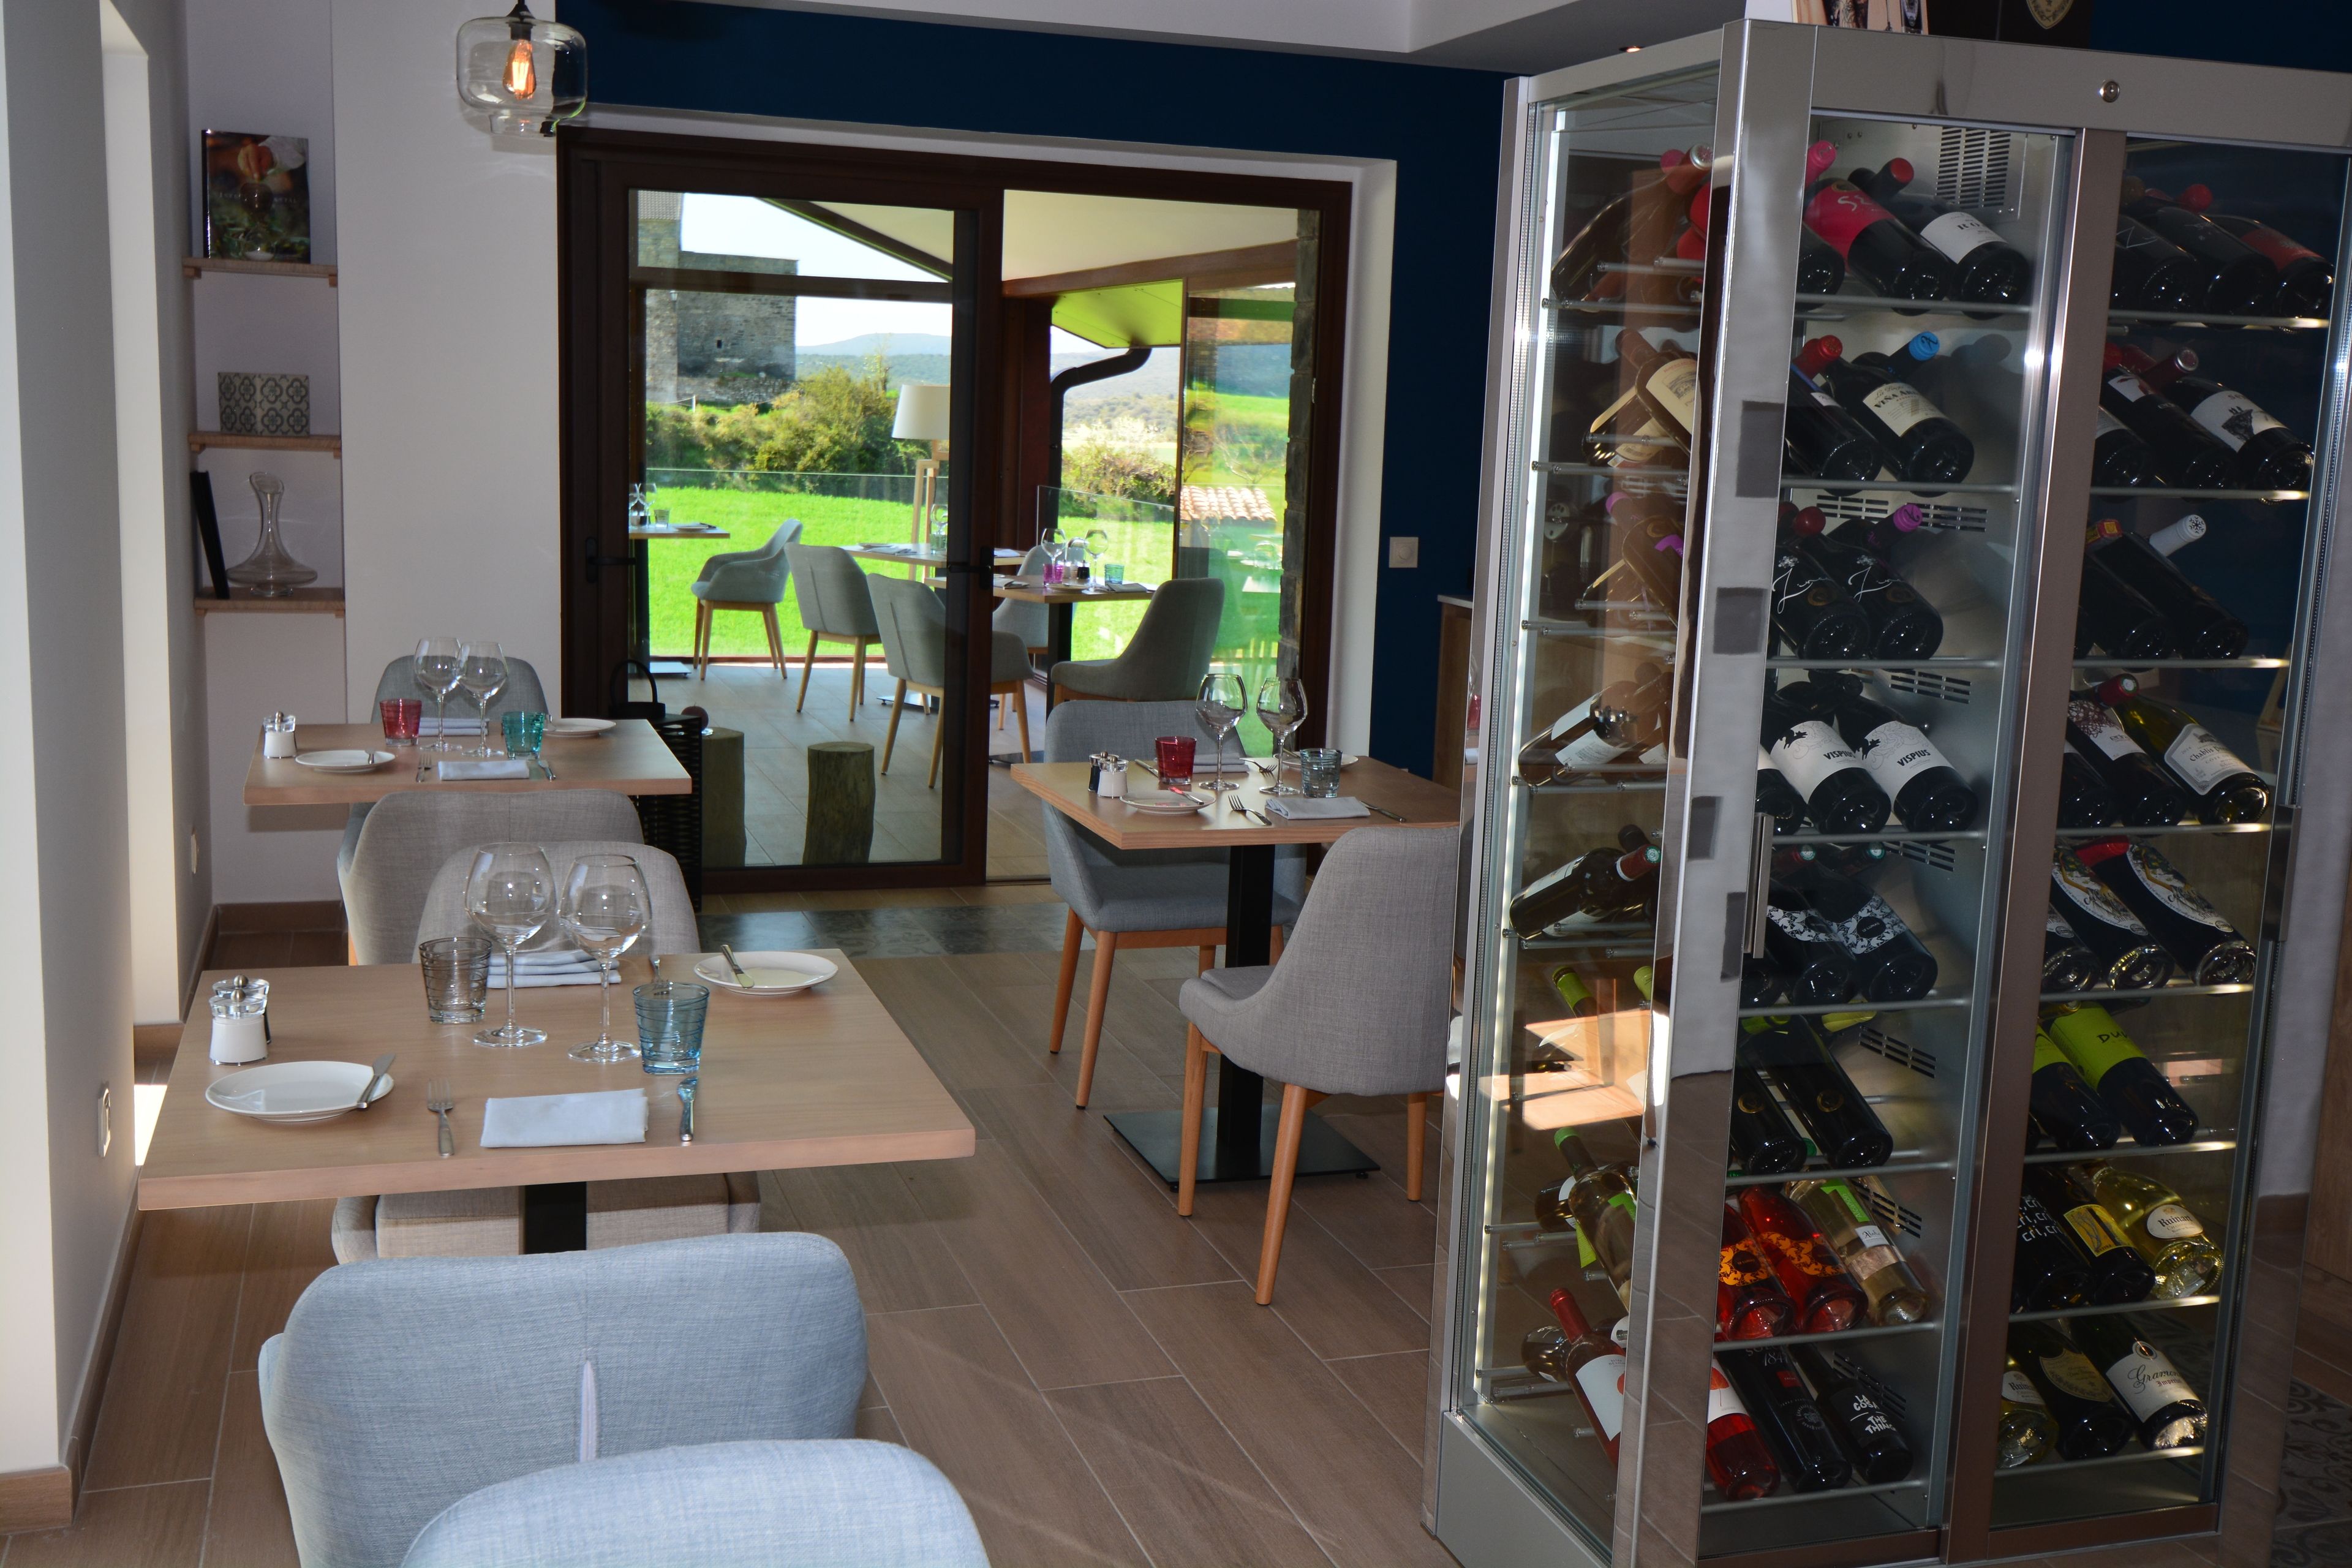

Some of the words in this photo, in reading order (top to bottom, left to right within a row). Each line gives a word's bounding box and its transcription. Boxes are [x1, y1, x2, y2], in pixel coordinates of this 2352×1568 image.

[1896, 749, 1931, 766] VISPIUS
[2189, 747, 2214, 762] Chablis
[1855, 1394, 1871, 1404] LA
[1853, 1400, 1881, 1411] COSA
[1867, 1415, 1888, 1425] THE
[1864, 1423, 1897, 1434] THING
